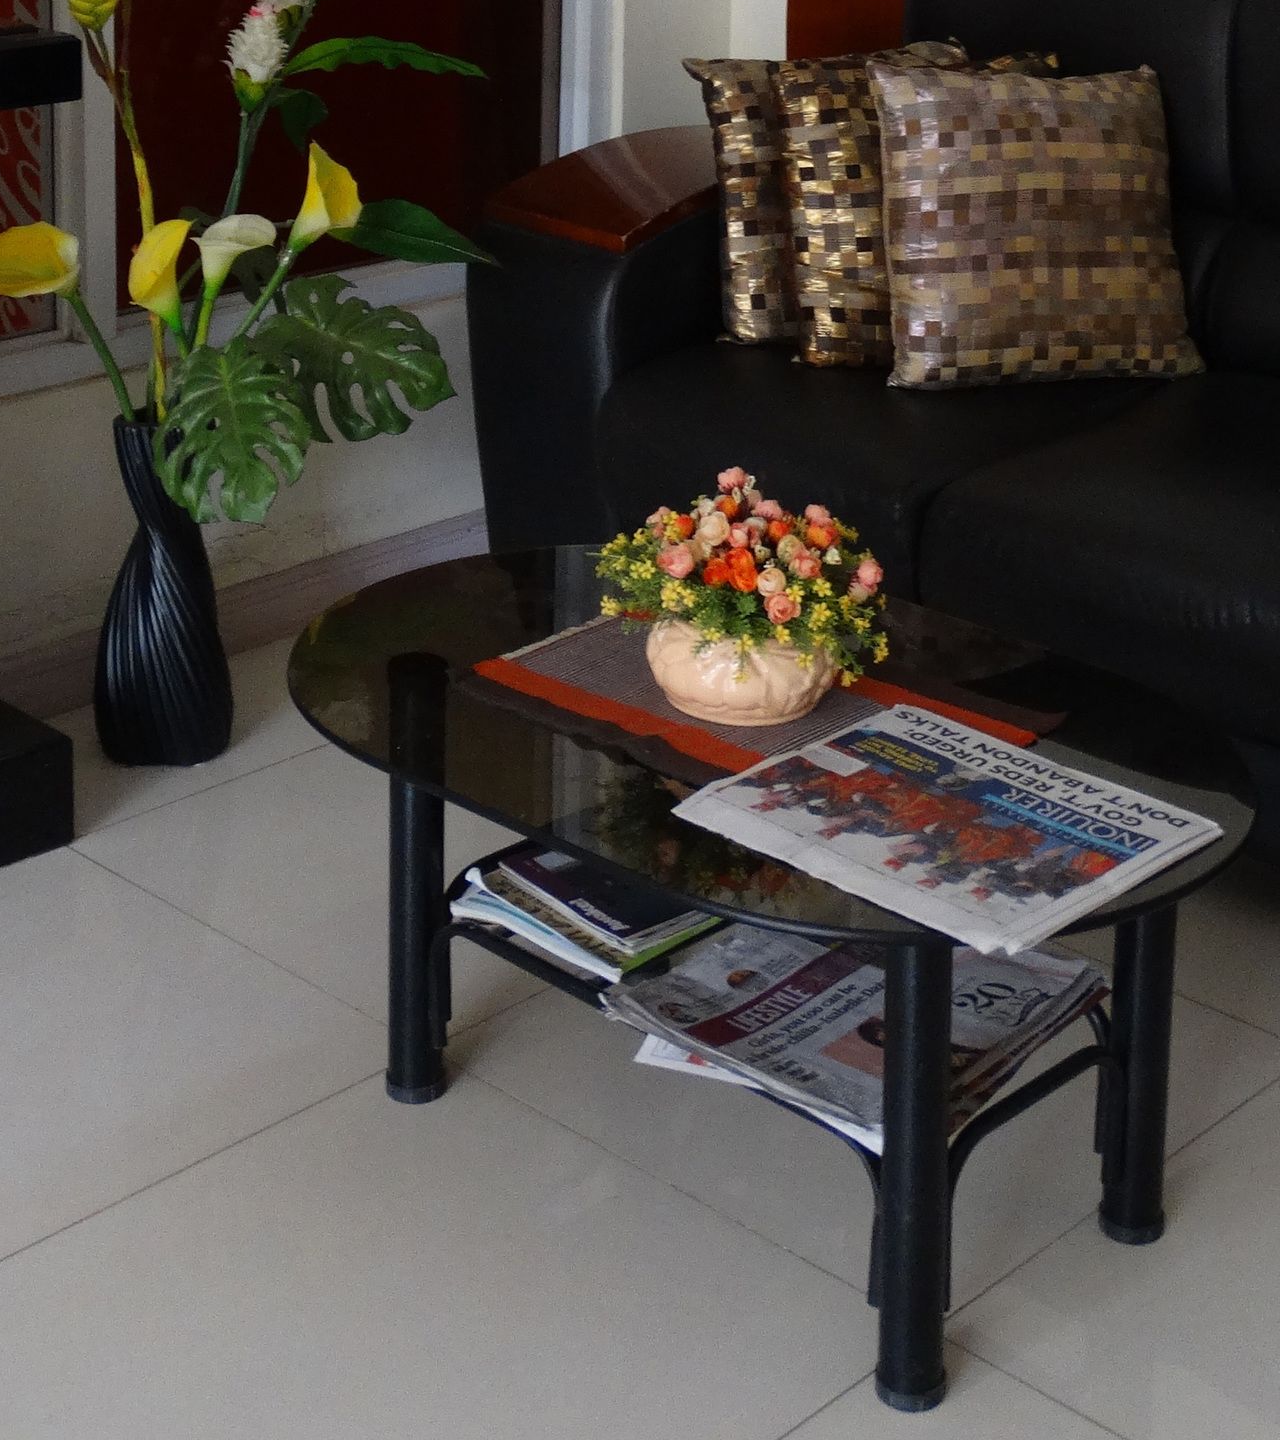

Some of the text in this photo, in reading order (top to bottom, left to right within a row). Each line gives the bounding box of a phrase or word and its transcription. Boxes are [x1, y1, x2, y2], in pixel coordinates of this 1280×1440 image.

[895, 709, 967, 744] TALKS
[973, 741, 1104, 795] ABANDON
[989, 763, 1056, 793] REDS
[1001, 788, 1157, 852] INQUIRER
[1102, 794, 1190, 829] DON'T
[726, 983, 816, 1033] LIFESTYLE
